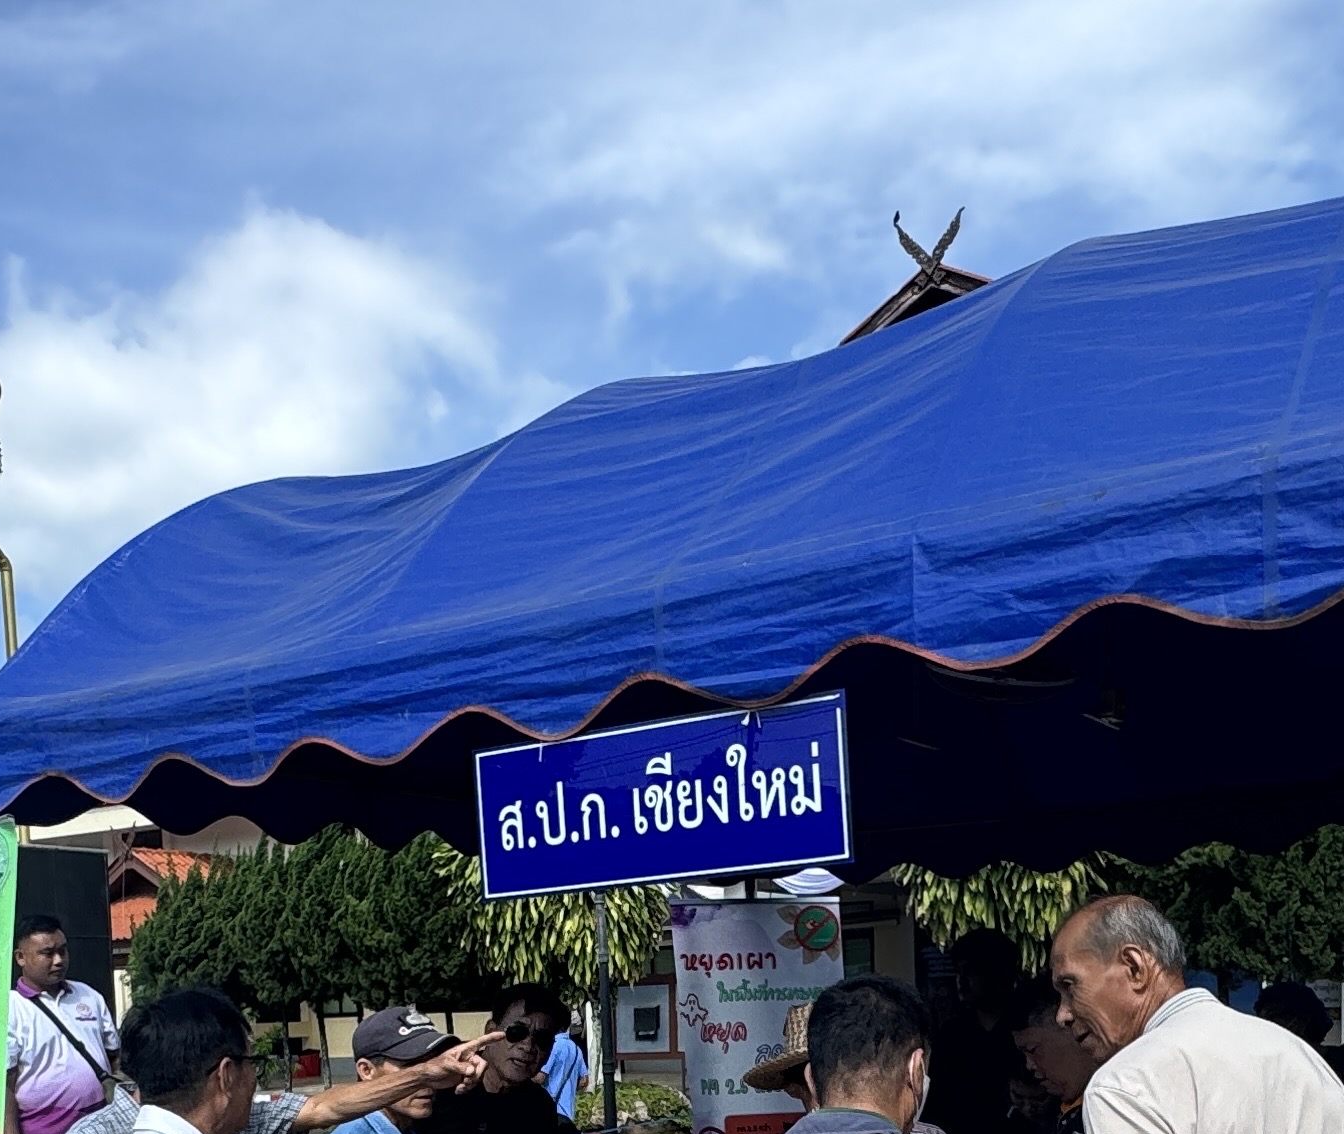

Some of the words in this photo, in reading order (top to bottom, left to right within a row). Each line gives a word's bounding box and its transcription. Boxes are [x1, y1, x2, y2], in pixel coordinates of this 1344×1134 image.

[499, 781, 620, 851] ส.ป.ก.
[632, 741, 822, 835] เชียงใหม่
[680, 952, 776, 978] หยุดเผา
[701, 1021, 748, 1053] หยุด
